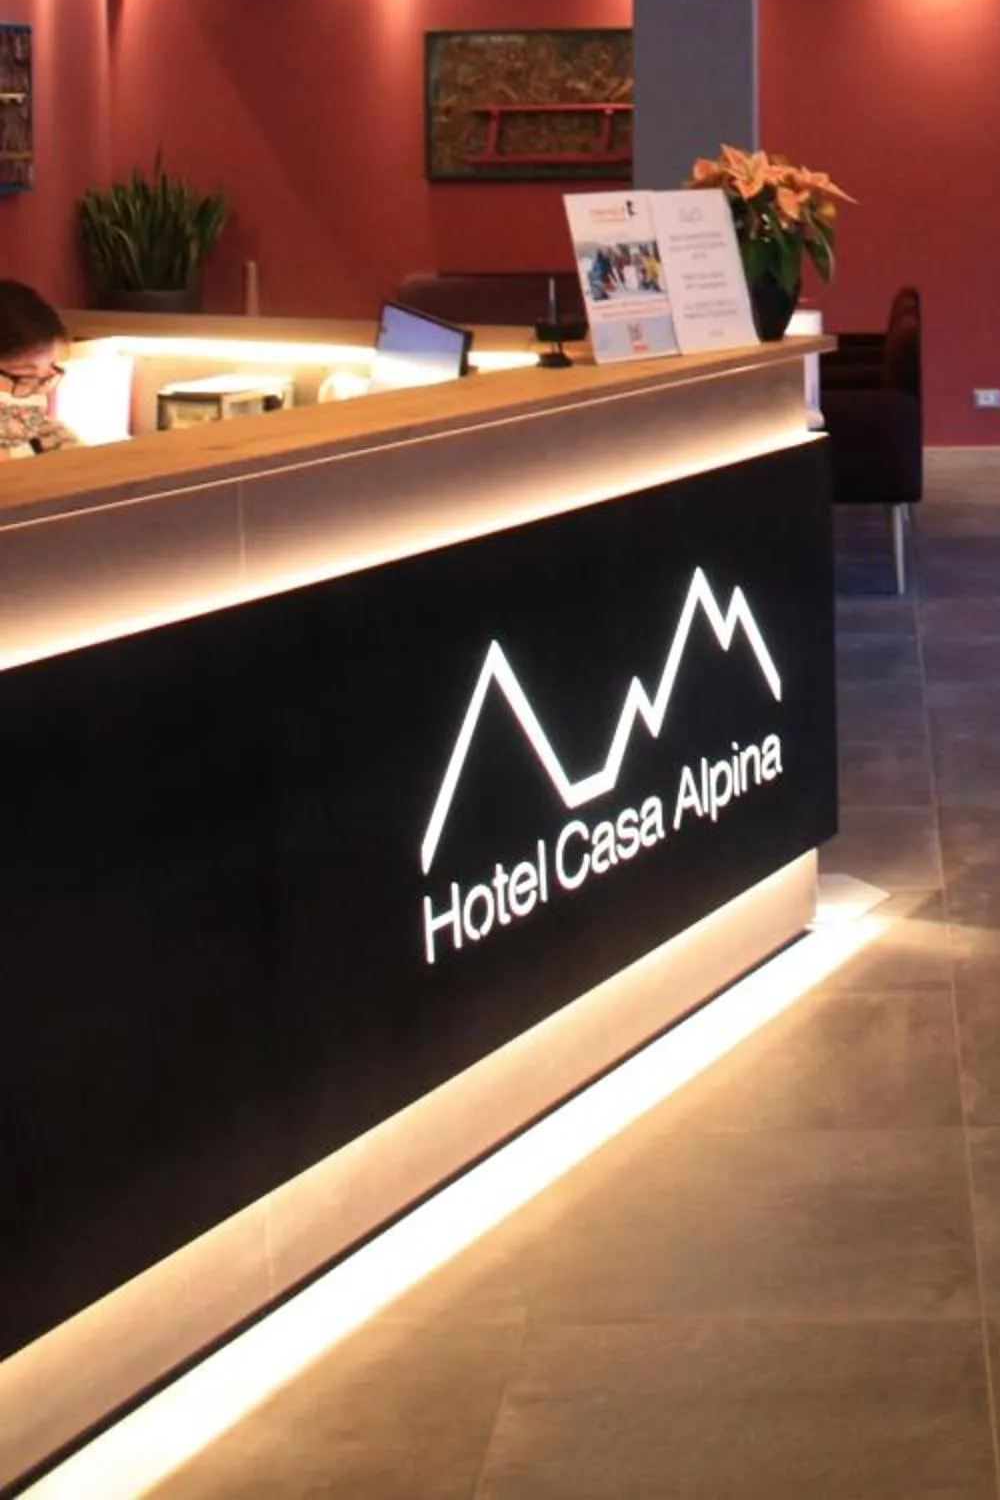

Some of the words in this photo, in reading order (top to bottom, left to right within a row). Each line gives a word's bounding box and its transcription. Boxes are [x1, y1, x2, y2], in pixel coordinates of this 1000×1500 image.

[423, 839, 548, 965] Hotel
[555, 795, 666, 890] Casa
[672, 733, 783, 831] Alpina
